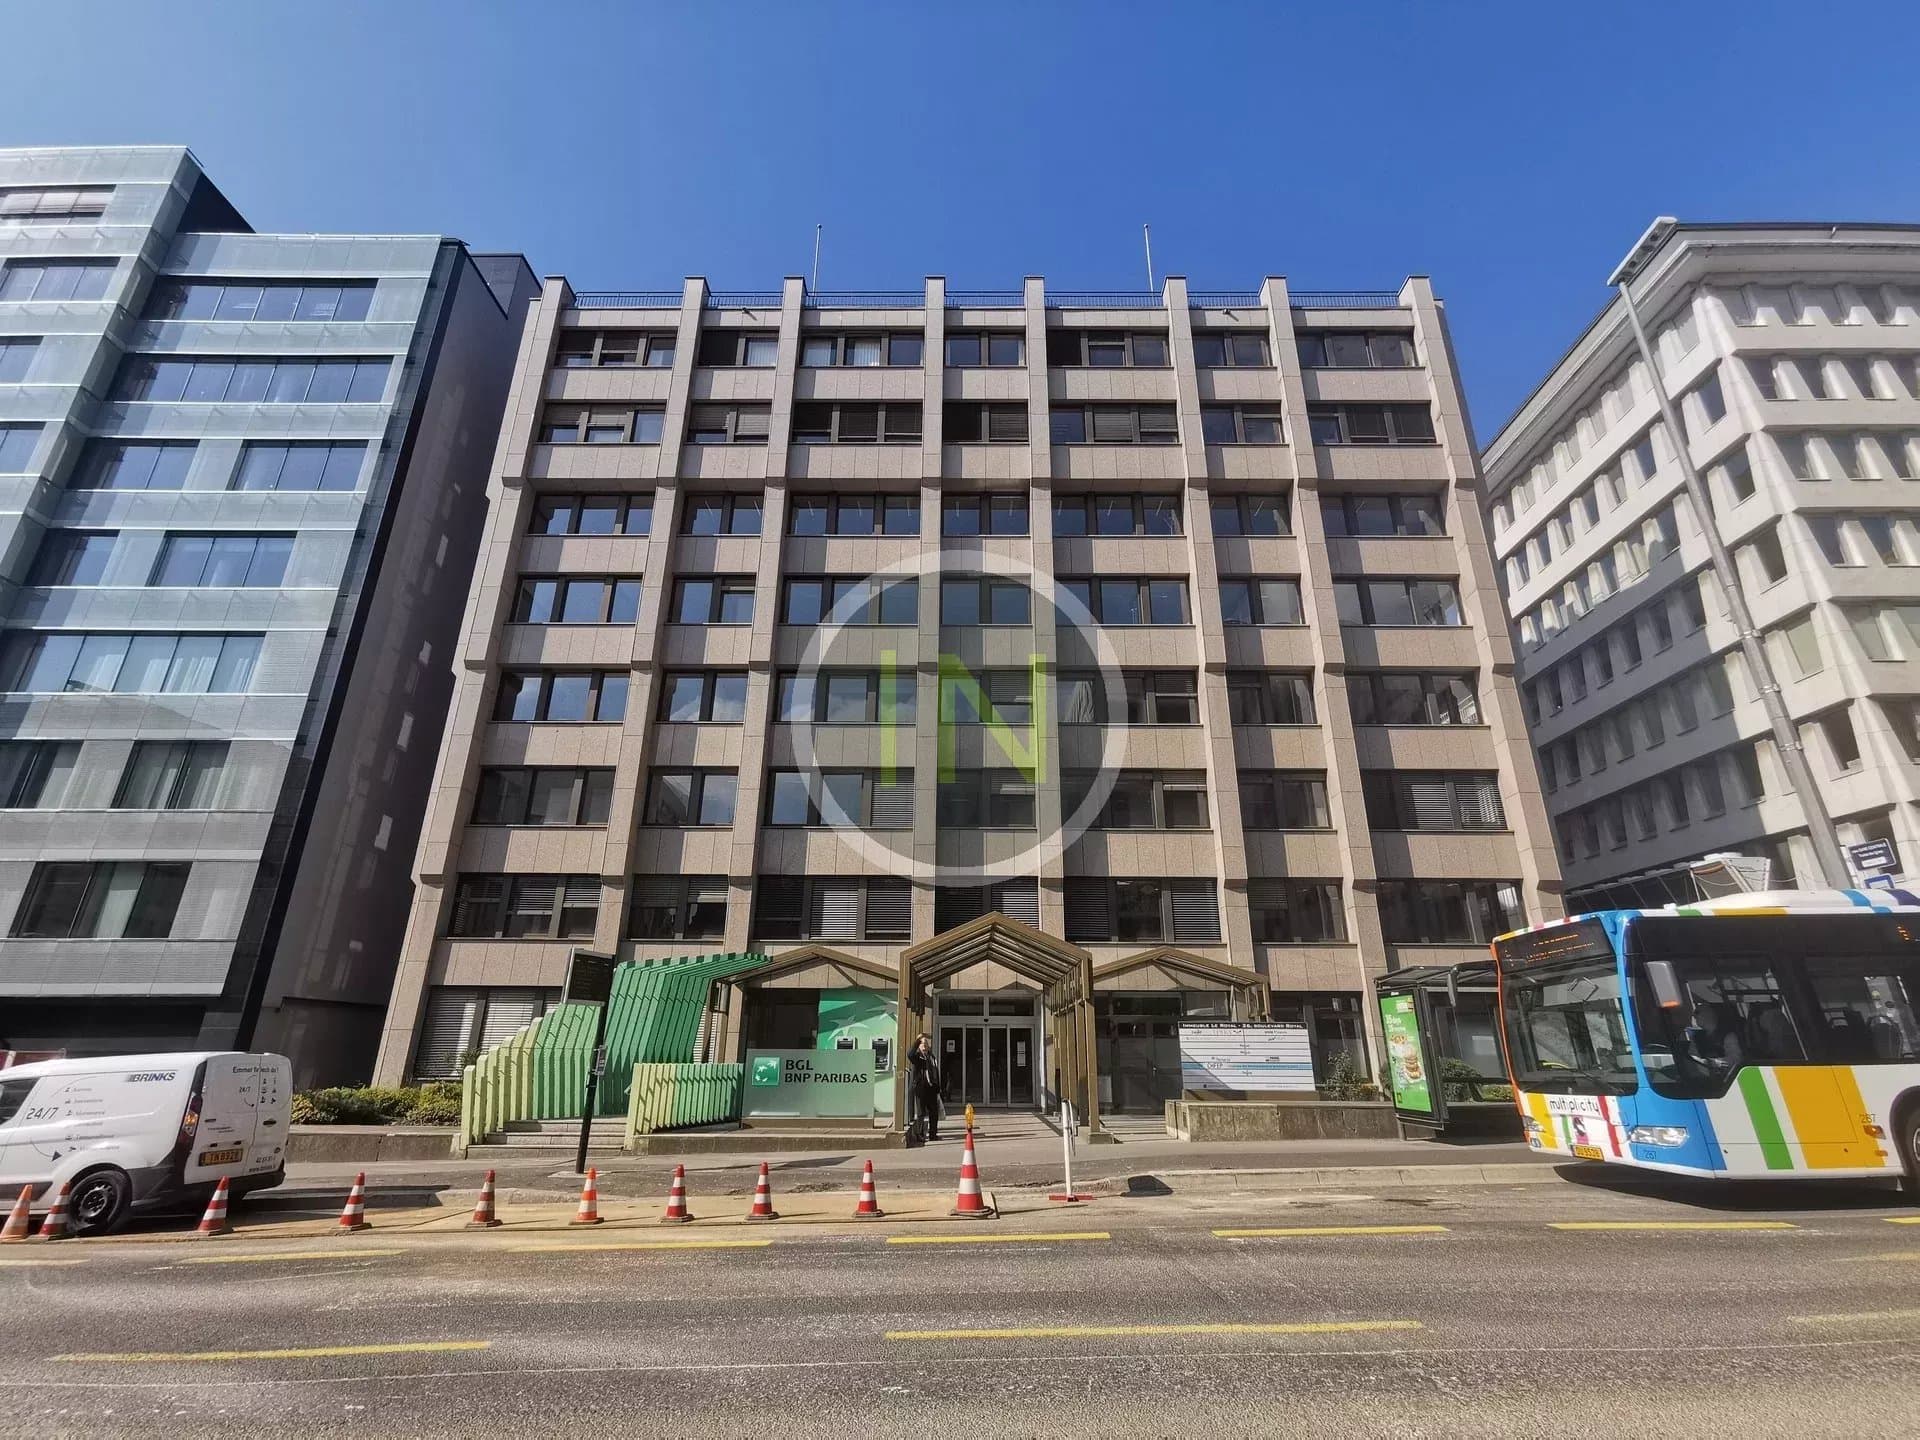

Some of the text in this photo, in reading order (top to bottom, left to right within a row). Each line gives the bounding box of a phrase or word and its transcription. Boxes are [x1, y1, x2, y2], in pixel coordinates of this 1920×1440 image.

[785, 1059, 814, 1071] BGL
[129, 1072, 176, 1083] BRINKS
[784, 1073, 868, 1083] BNP PARIBAS
[26, 1107, 59, 1120] 24/7
